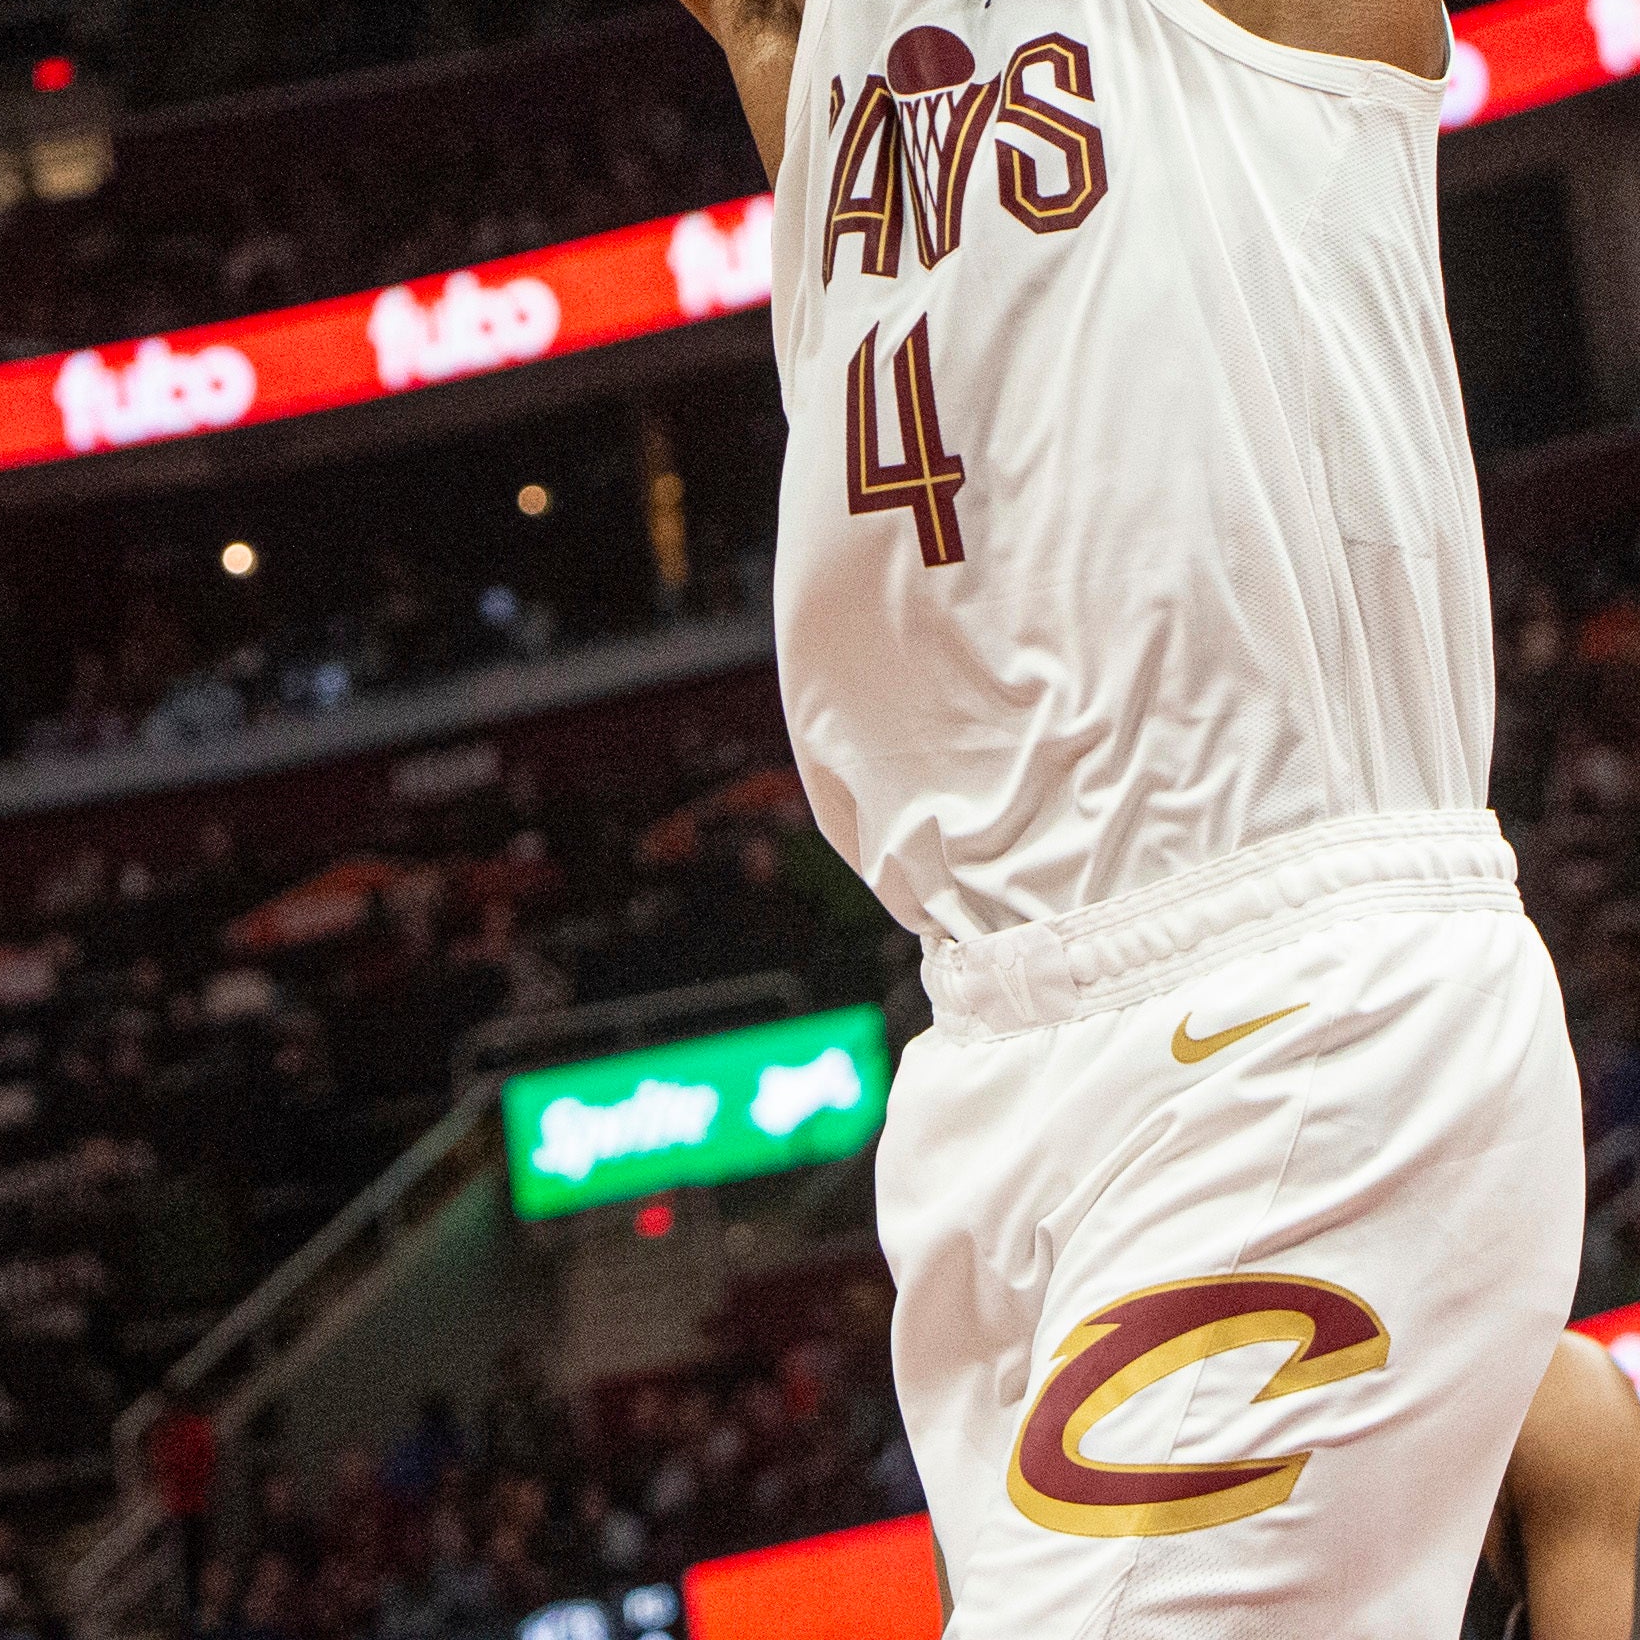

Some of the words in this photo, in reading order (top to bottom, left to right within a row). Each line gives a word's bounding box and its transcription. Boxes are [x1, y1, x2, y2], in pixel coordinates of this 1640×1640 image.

[824, 30, 1109, 294] AVS
[54, 337, 258, 453] fubo
[368, 271, 560, 391] fubo
[847, 312, 966, 568] 4
